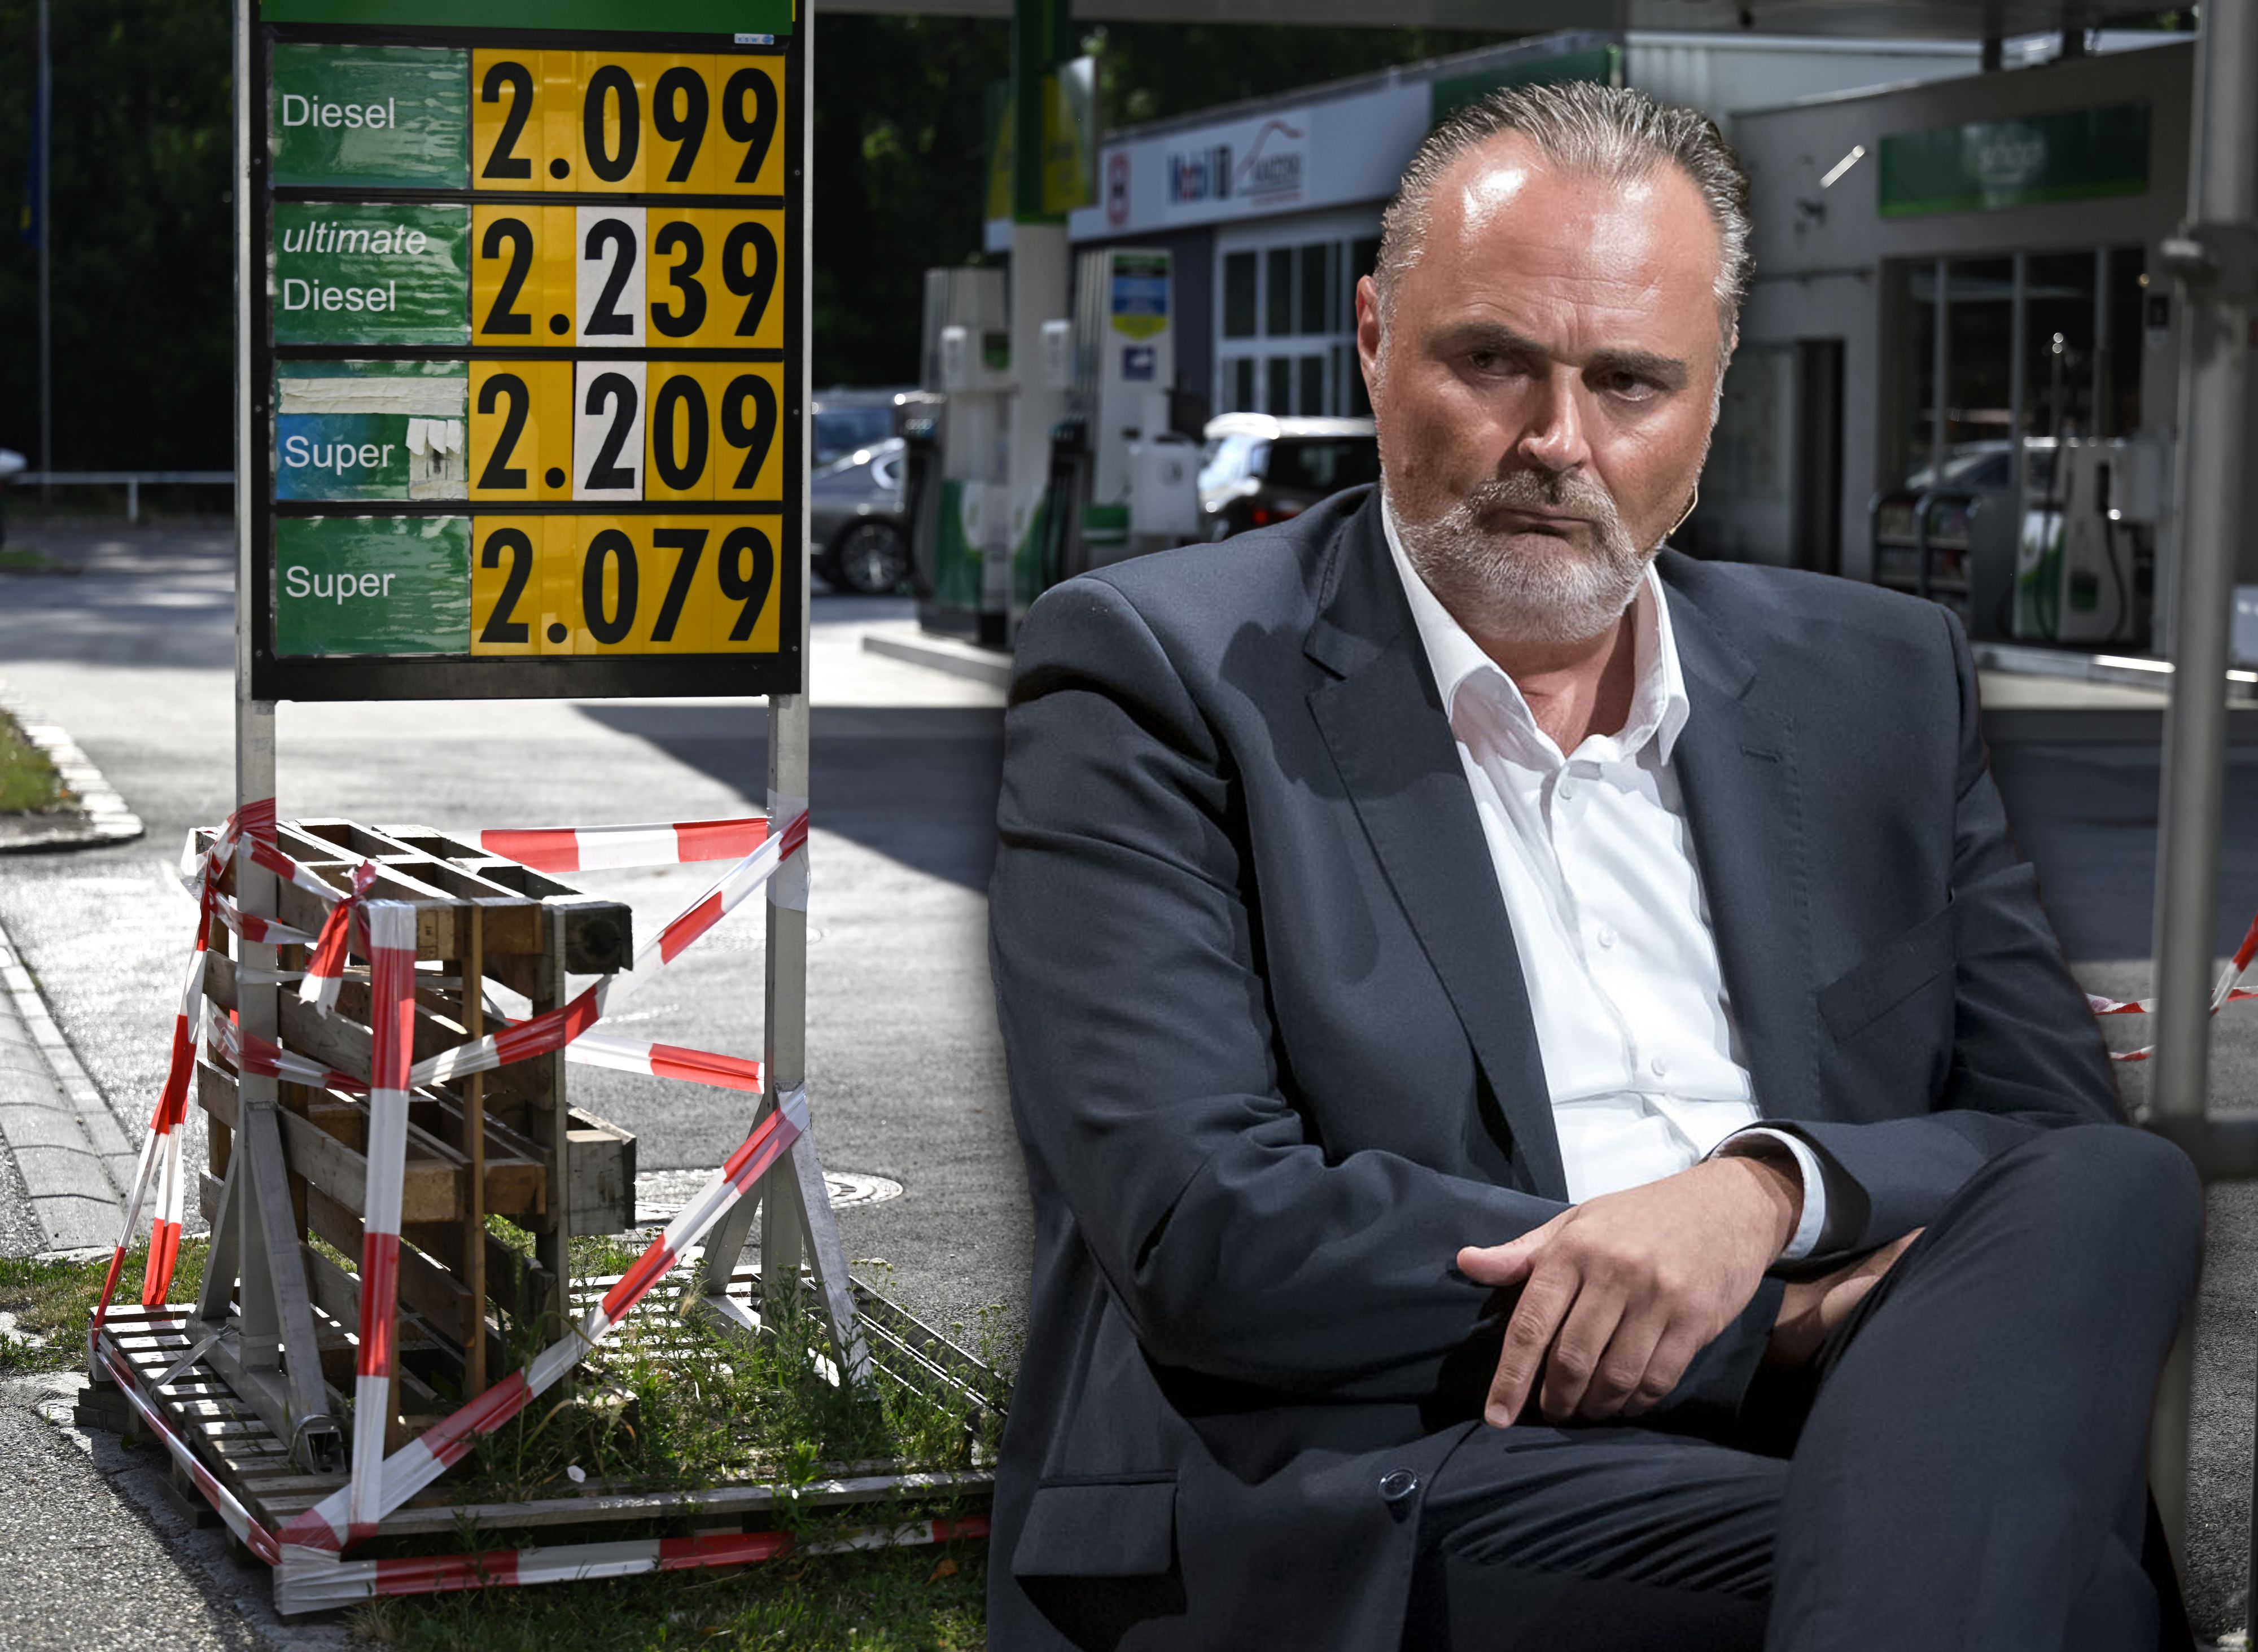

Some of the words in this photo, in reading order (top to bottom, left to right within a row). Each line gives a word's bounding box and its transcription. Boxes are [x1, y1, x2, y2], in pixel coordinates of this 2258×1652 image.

[283, 94, 395, 129] Diesel
[481, 61, 778, 183] 2.099
[283, 221, 427, 255] ultimate
[284, 279, 396, 312] Diesel
[481, 218, 778, 338] 2.239
[285, 436, 395, 475] Super
[477, 372, 777, 490] 2.209
[286, 566, 396, 605] Super
[479, 527, 774, 645] 2.079
